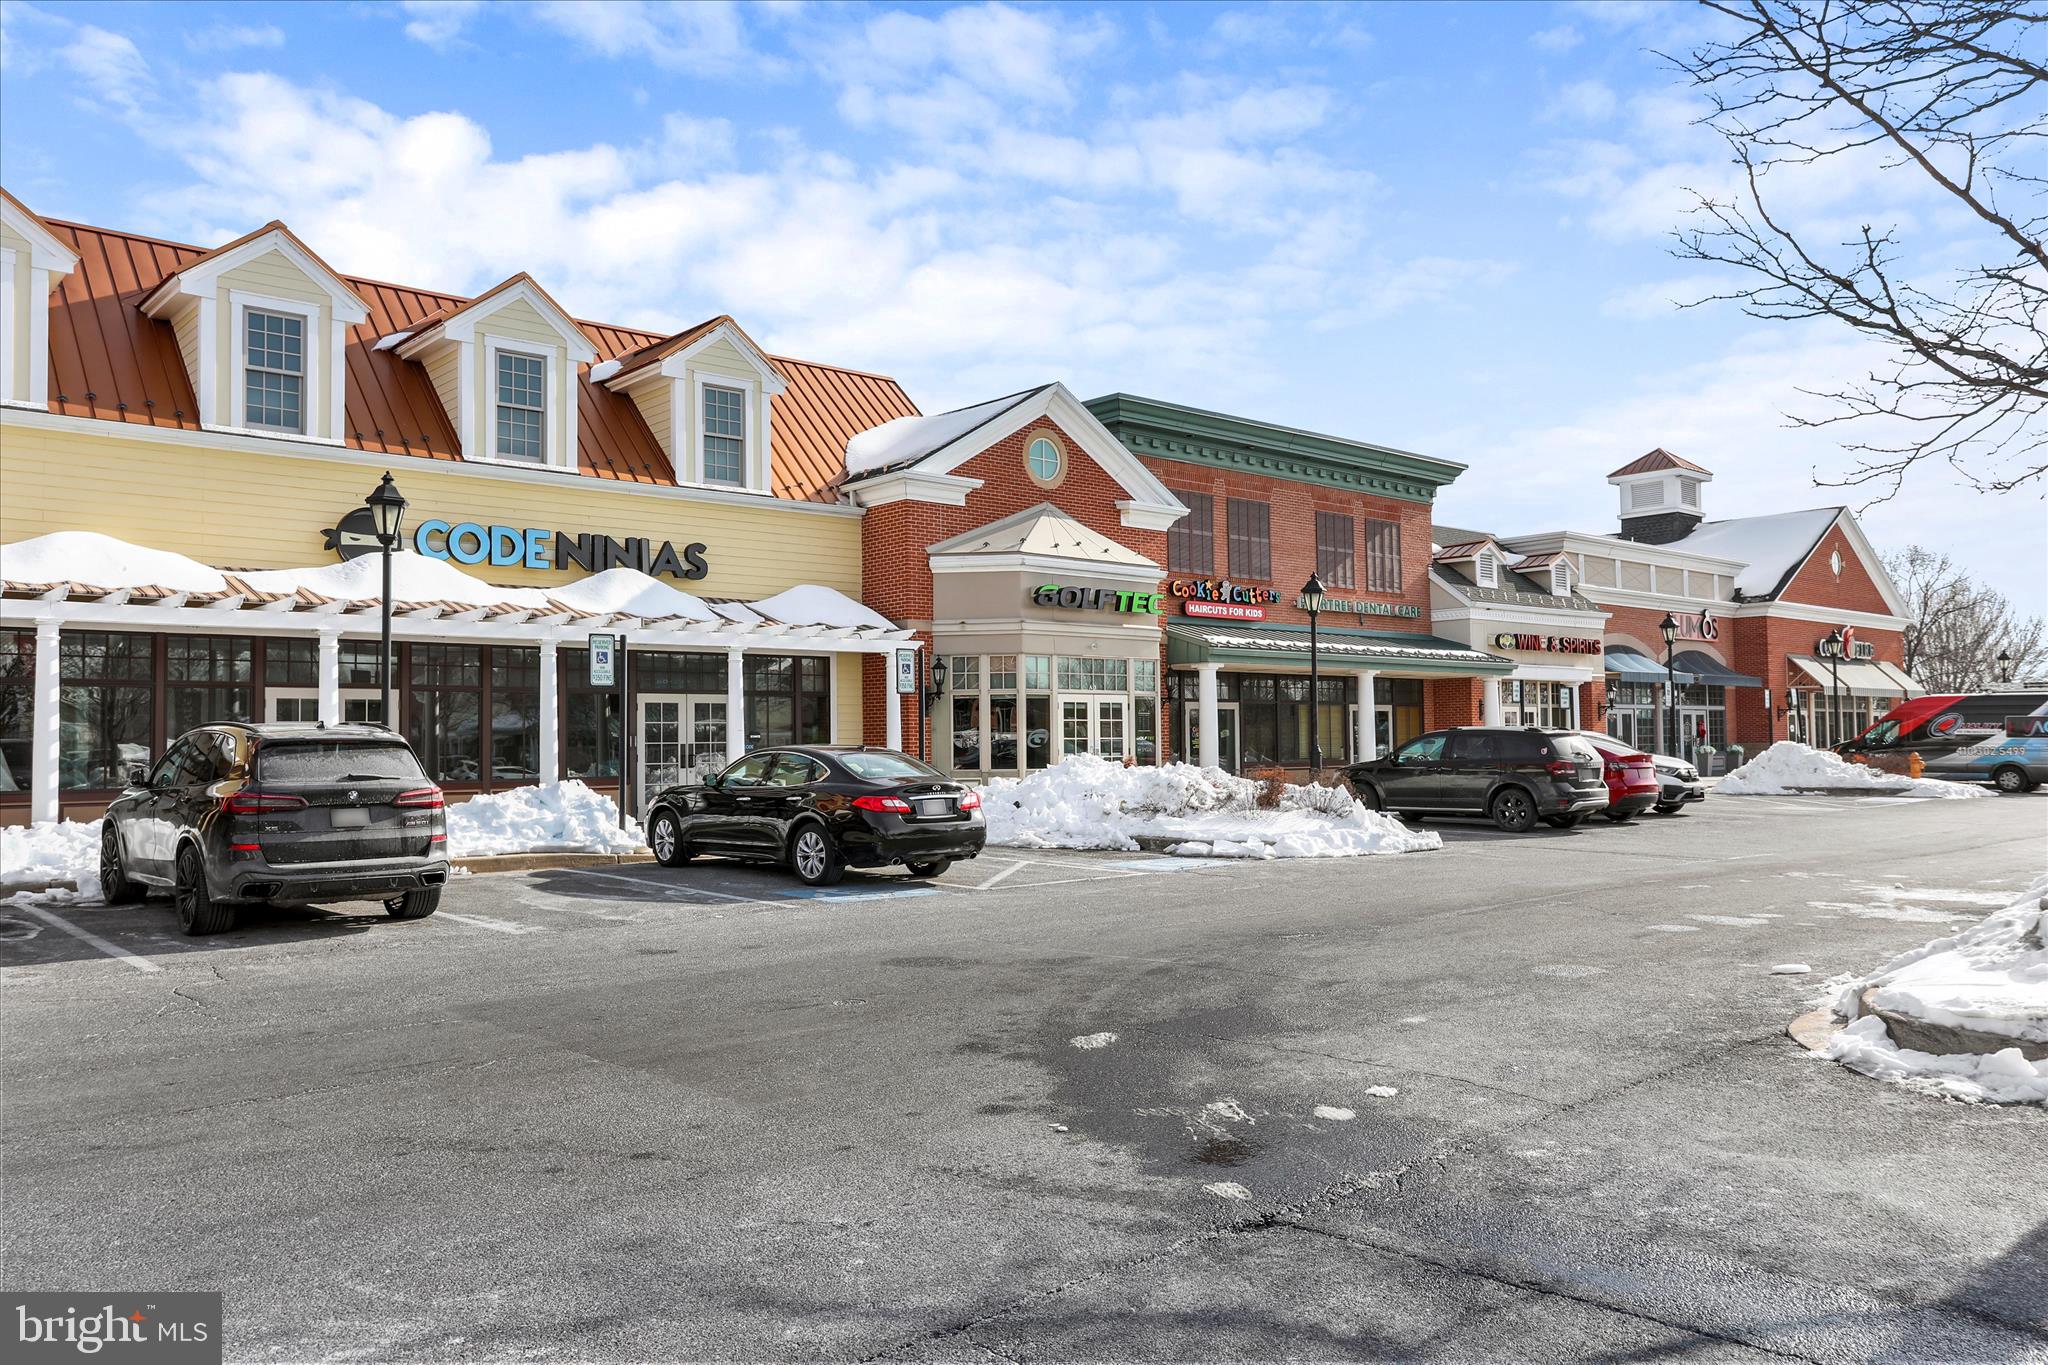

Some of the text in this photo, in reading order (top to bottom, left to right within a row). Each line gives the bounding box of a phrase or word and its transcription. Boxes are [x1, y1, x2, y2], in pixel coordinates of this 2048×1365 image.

[414, 519, 550, 569] CODE
[1033, 584, 1165, 614] GOLFTEC
[1171, 579, 1281, 604] Cookie Cutters
[1188, 604, 1263, 618] HAIRCUTS FOR KIDS
[1300, 596, 1421, 617] PRTREE DENTAL CARE
[1518, 633, 1601, 655] WINE & SPIRITS
